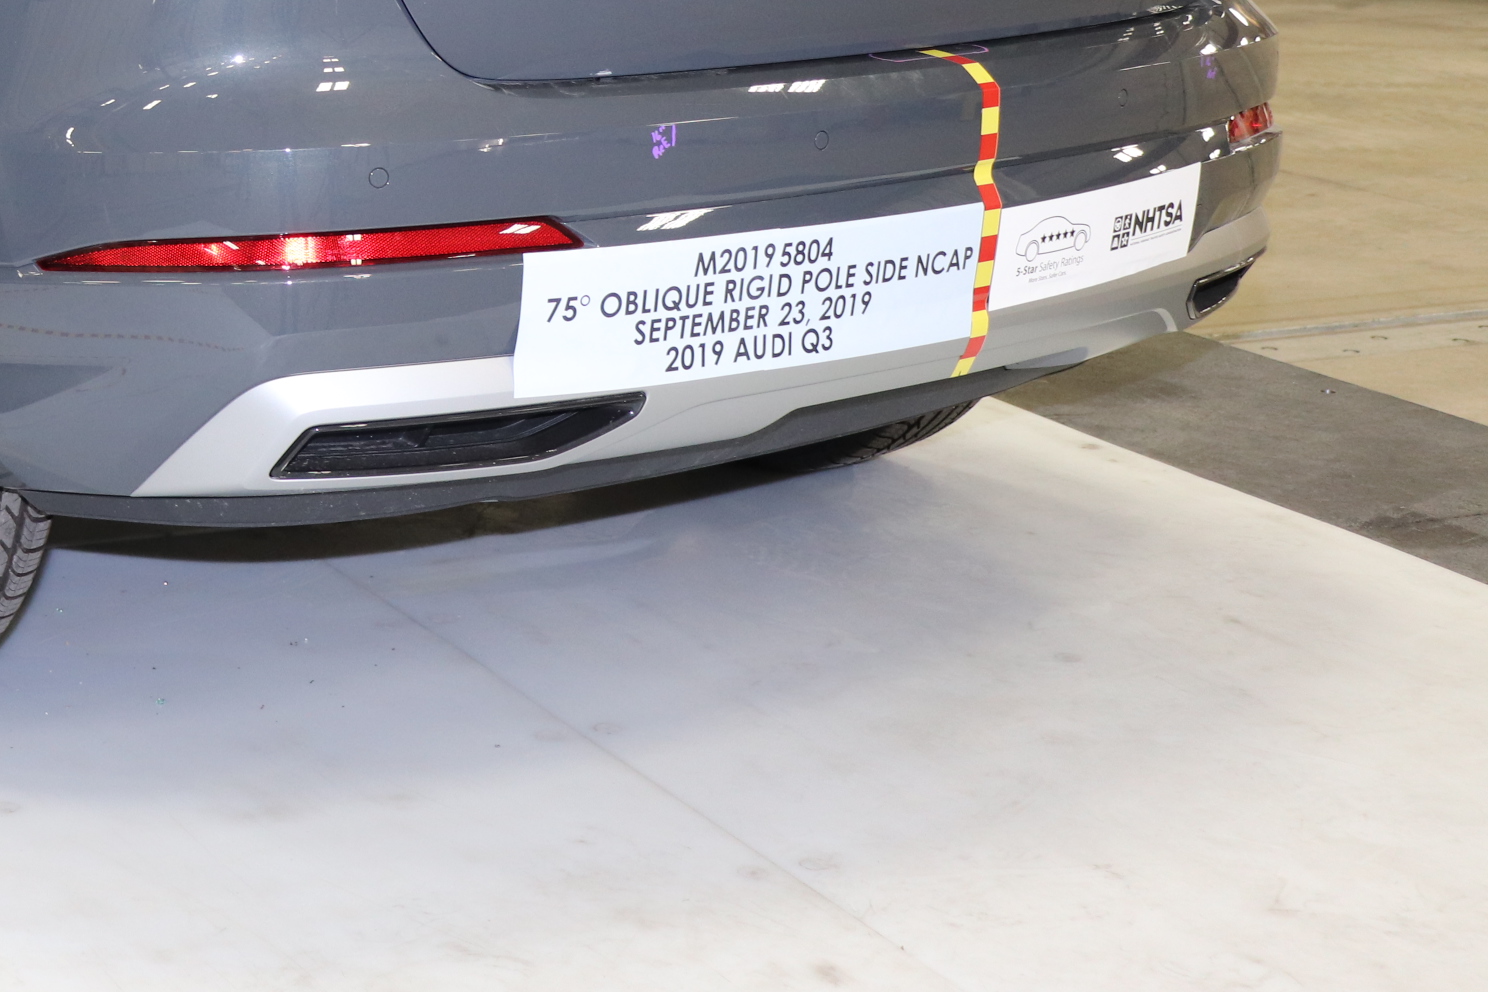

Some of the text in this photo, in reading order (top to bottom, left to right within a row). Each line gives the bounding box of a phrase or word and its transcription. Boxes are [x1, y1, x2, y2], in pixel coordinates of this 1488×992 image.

[1131, 199, 1183, 236] NHTSA
[694, 236, 834, 278] M20195804
[1015, 255, 1084, 277] 5-Star Safety Ratings
[545, 246, 974, 323] 75° OBLIQUE RIGID POLE SIDE NCAP
[633, 291, 873, 346] SEPTEMBER 23, 2019
[664, 326, 834, 373] 2019 AUDI Q3
